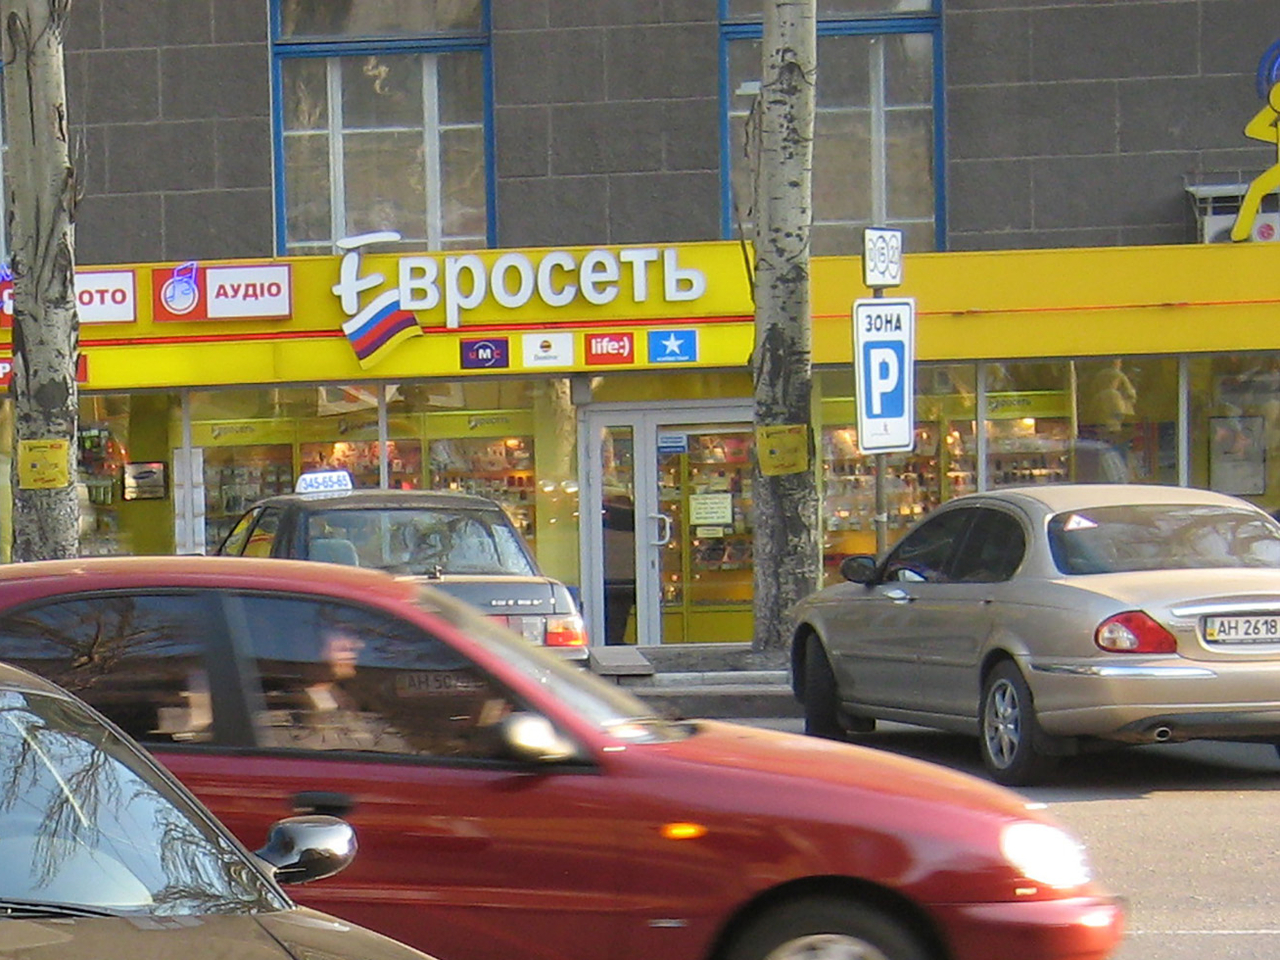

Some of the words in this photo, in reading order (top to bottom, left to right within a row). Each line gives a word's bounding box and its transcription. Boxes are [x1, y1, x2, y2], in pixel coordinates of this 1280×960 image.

[78, 288, 127, 306] ОТО
[214, 282, 282, 301] АУДІО
[865, 313, 902, 333] ЗОНА
[591, 336, 629, 358] life:)
[870, 347, 900, 415] P
[1243, 619, 1278, 636] 2618
